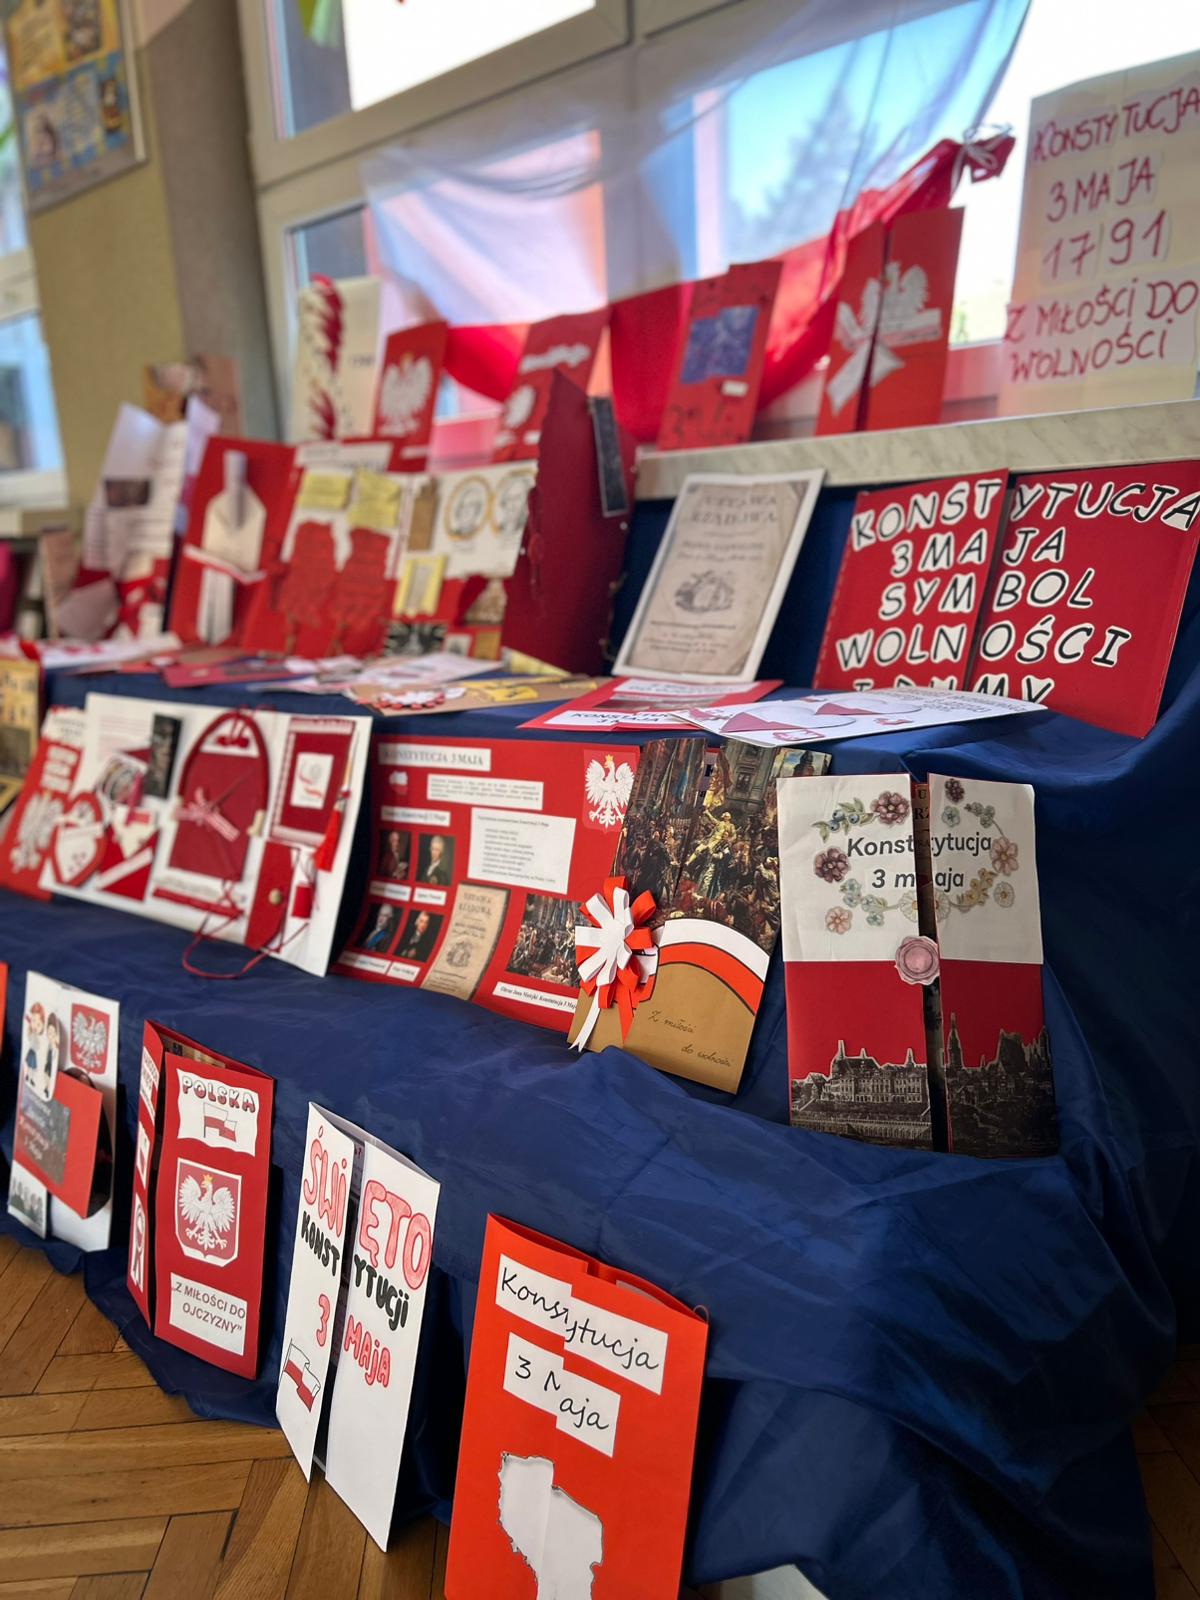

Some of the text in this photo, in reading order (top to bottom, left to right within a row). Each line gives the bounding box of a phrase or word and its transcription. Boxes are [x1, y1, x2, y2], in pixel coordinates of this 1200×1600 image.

[1033, 86, 1200, 161] KONSTYTUCJA
[1047, 156, 1155, 223] 3 MAJA
[1043, 209, 1166, 277] 1791
[1004, 304, 1026, 343] Z
[1146, 281, 1199, 320] DO
[893, 543, 911, 575] 3
[871, 868, 886, 889] 3
[181, 1075, 256, 1113] POLSKA
[184, 1285, 228, 1313] MIŁOŚCI
[229, 1304, 246, 1319] DO
[316, 1293, 331, 1347] 3
[514, 1355, 532, 1380] 3
